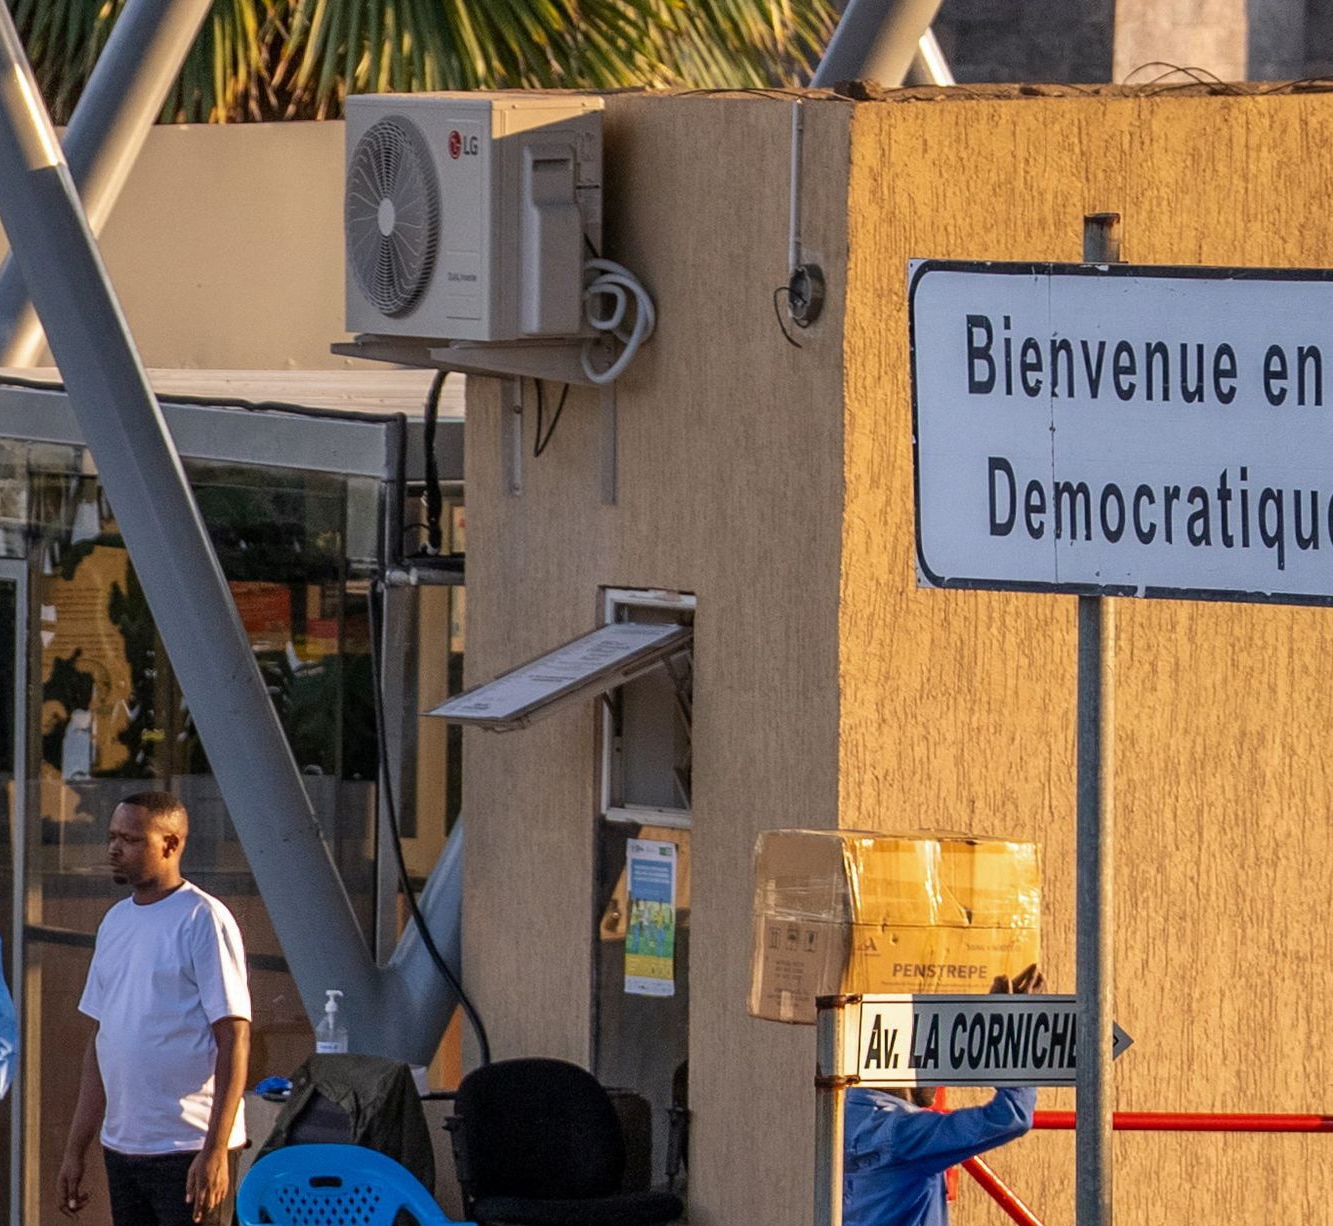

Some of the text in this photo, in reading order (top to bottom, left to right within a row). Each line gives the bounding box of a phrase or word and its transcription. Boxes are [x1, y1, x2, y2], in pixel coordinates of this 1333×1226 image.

[463, 135, 478, 156] LG
[965, 313, 1324, 407] Bienvenue en
[864, 1013, 900, 1070] Av.
[908, 1013, 940, 1070] LA
